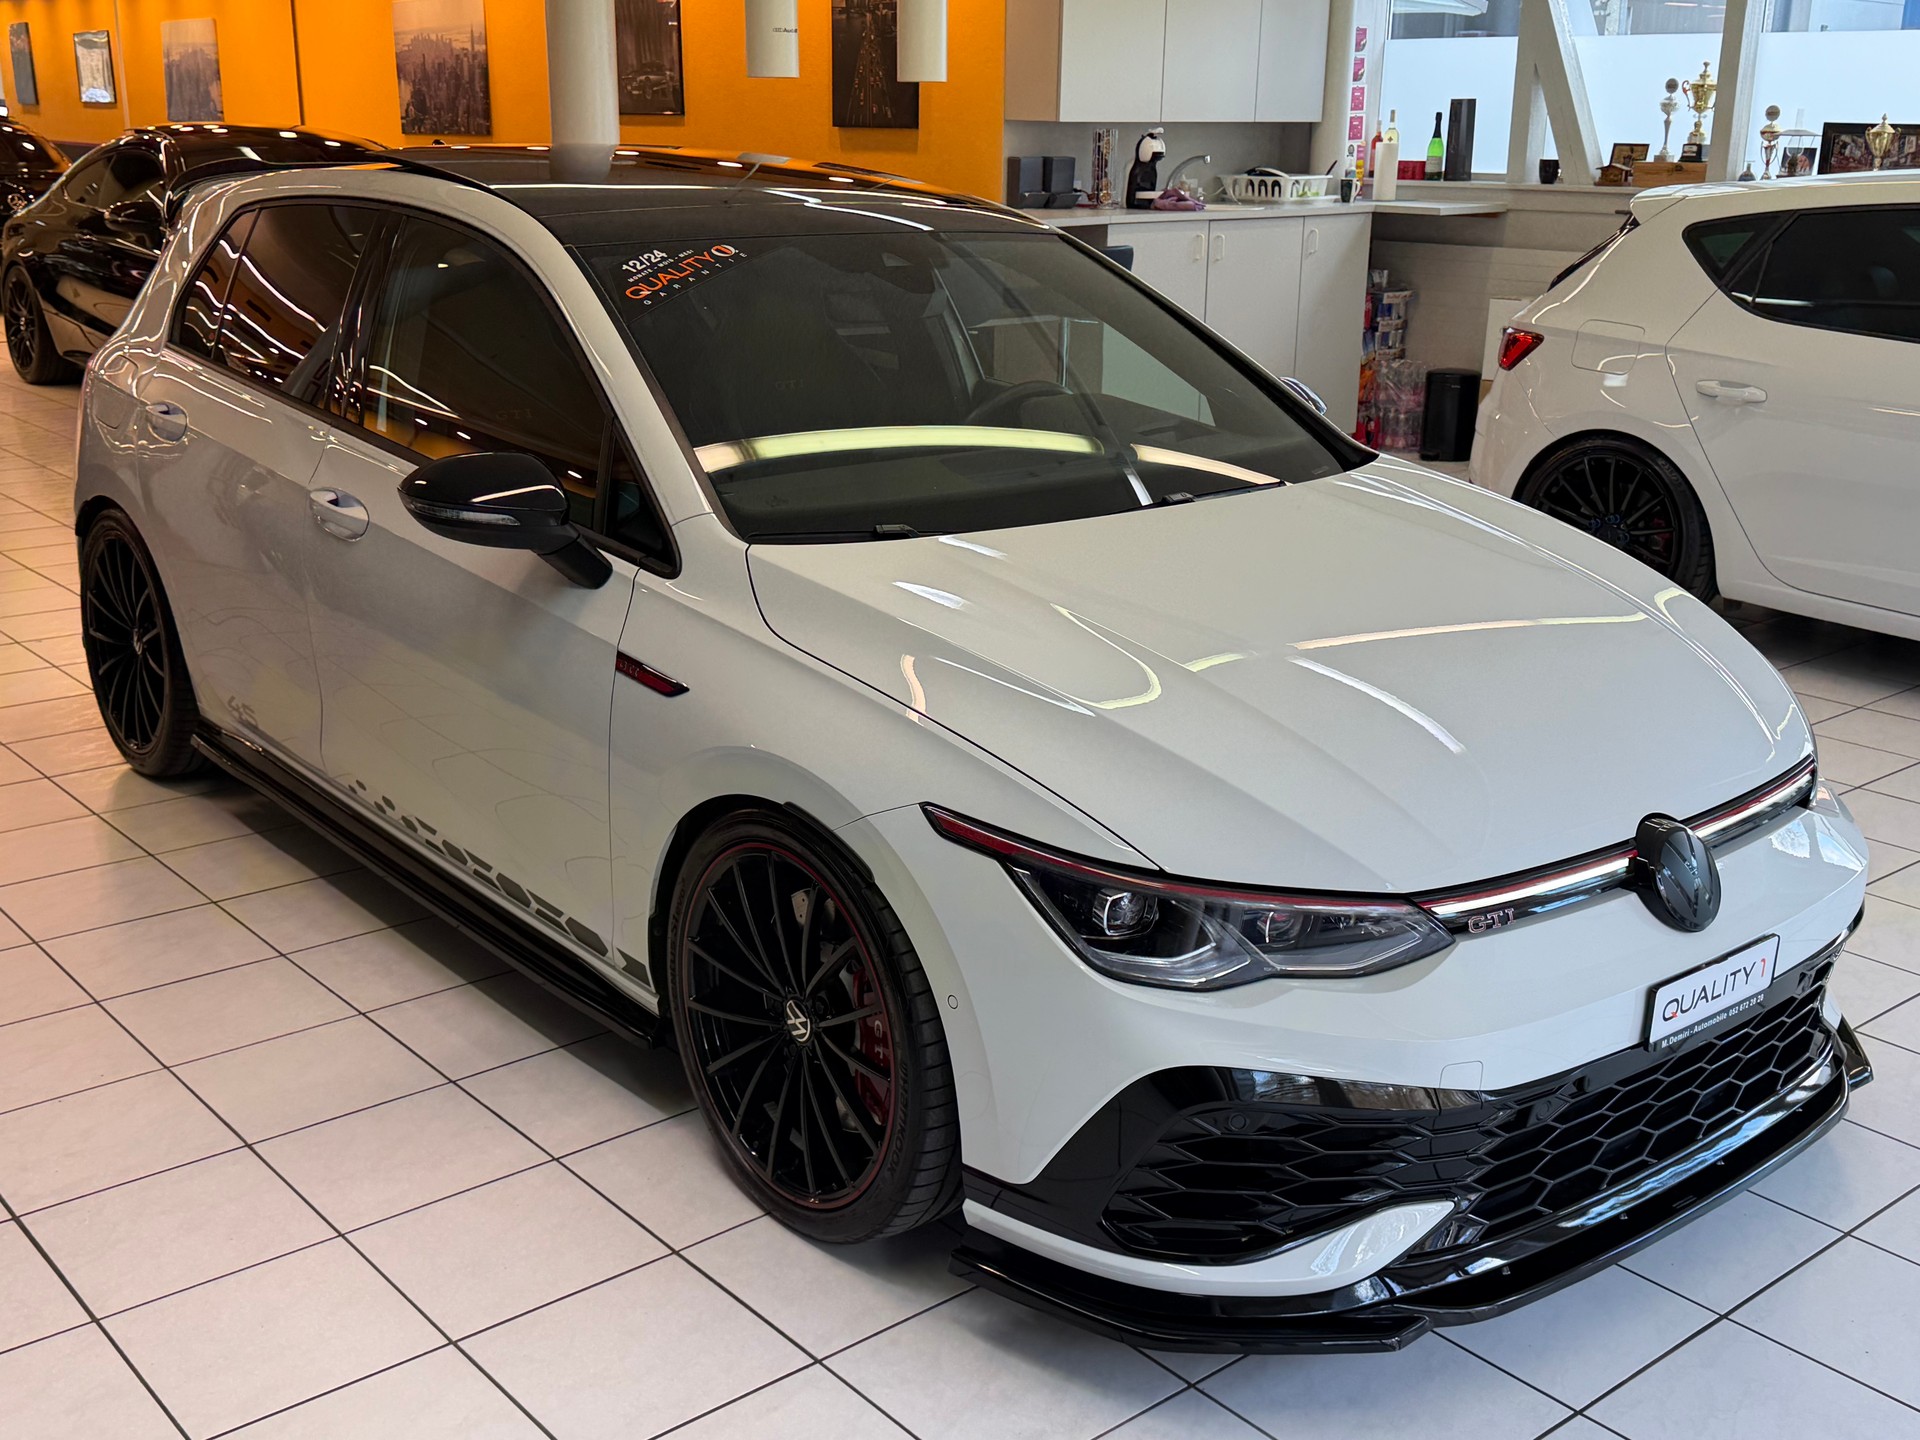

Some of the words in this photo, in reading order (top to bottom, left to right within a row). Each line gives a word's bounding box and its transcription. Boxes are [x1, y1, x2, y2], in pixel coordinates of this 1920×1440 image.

[622, 249, 668, 273] 12/24
[625, 251, 716, 299] QUALITY
[627, 266, 653, 283] MONATE
[643, 252, 747, 305] GARANTIE
[1467, 907, 1516, 933] GTI
[1662, 961, 1757, 1022] QUALITY
[1760, 958, 1767, 978] 1
[1669, 1029, 1690, 1044] Demiri
[1693, 1013, 1728, 1032] Automobile
[1728, 1006, 1739, 1017] 052
